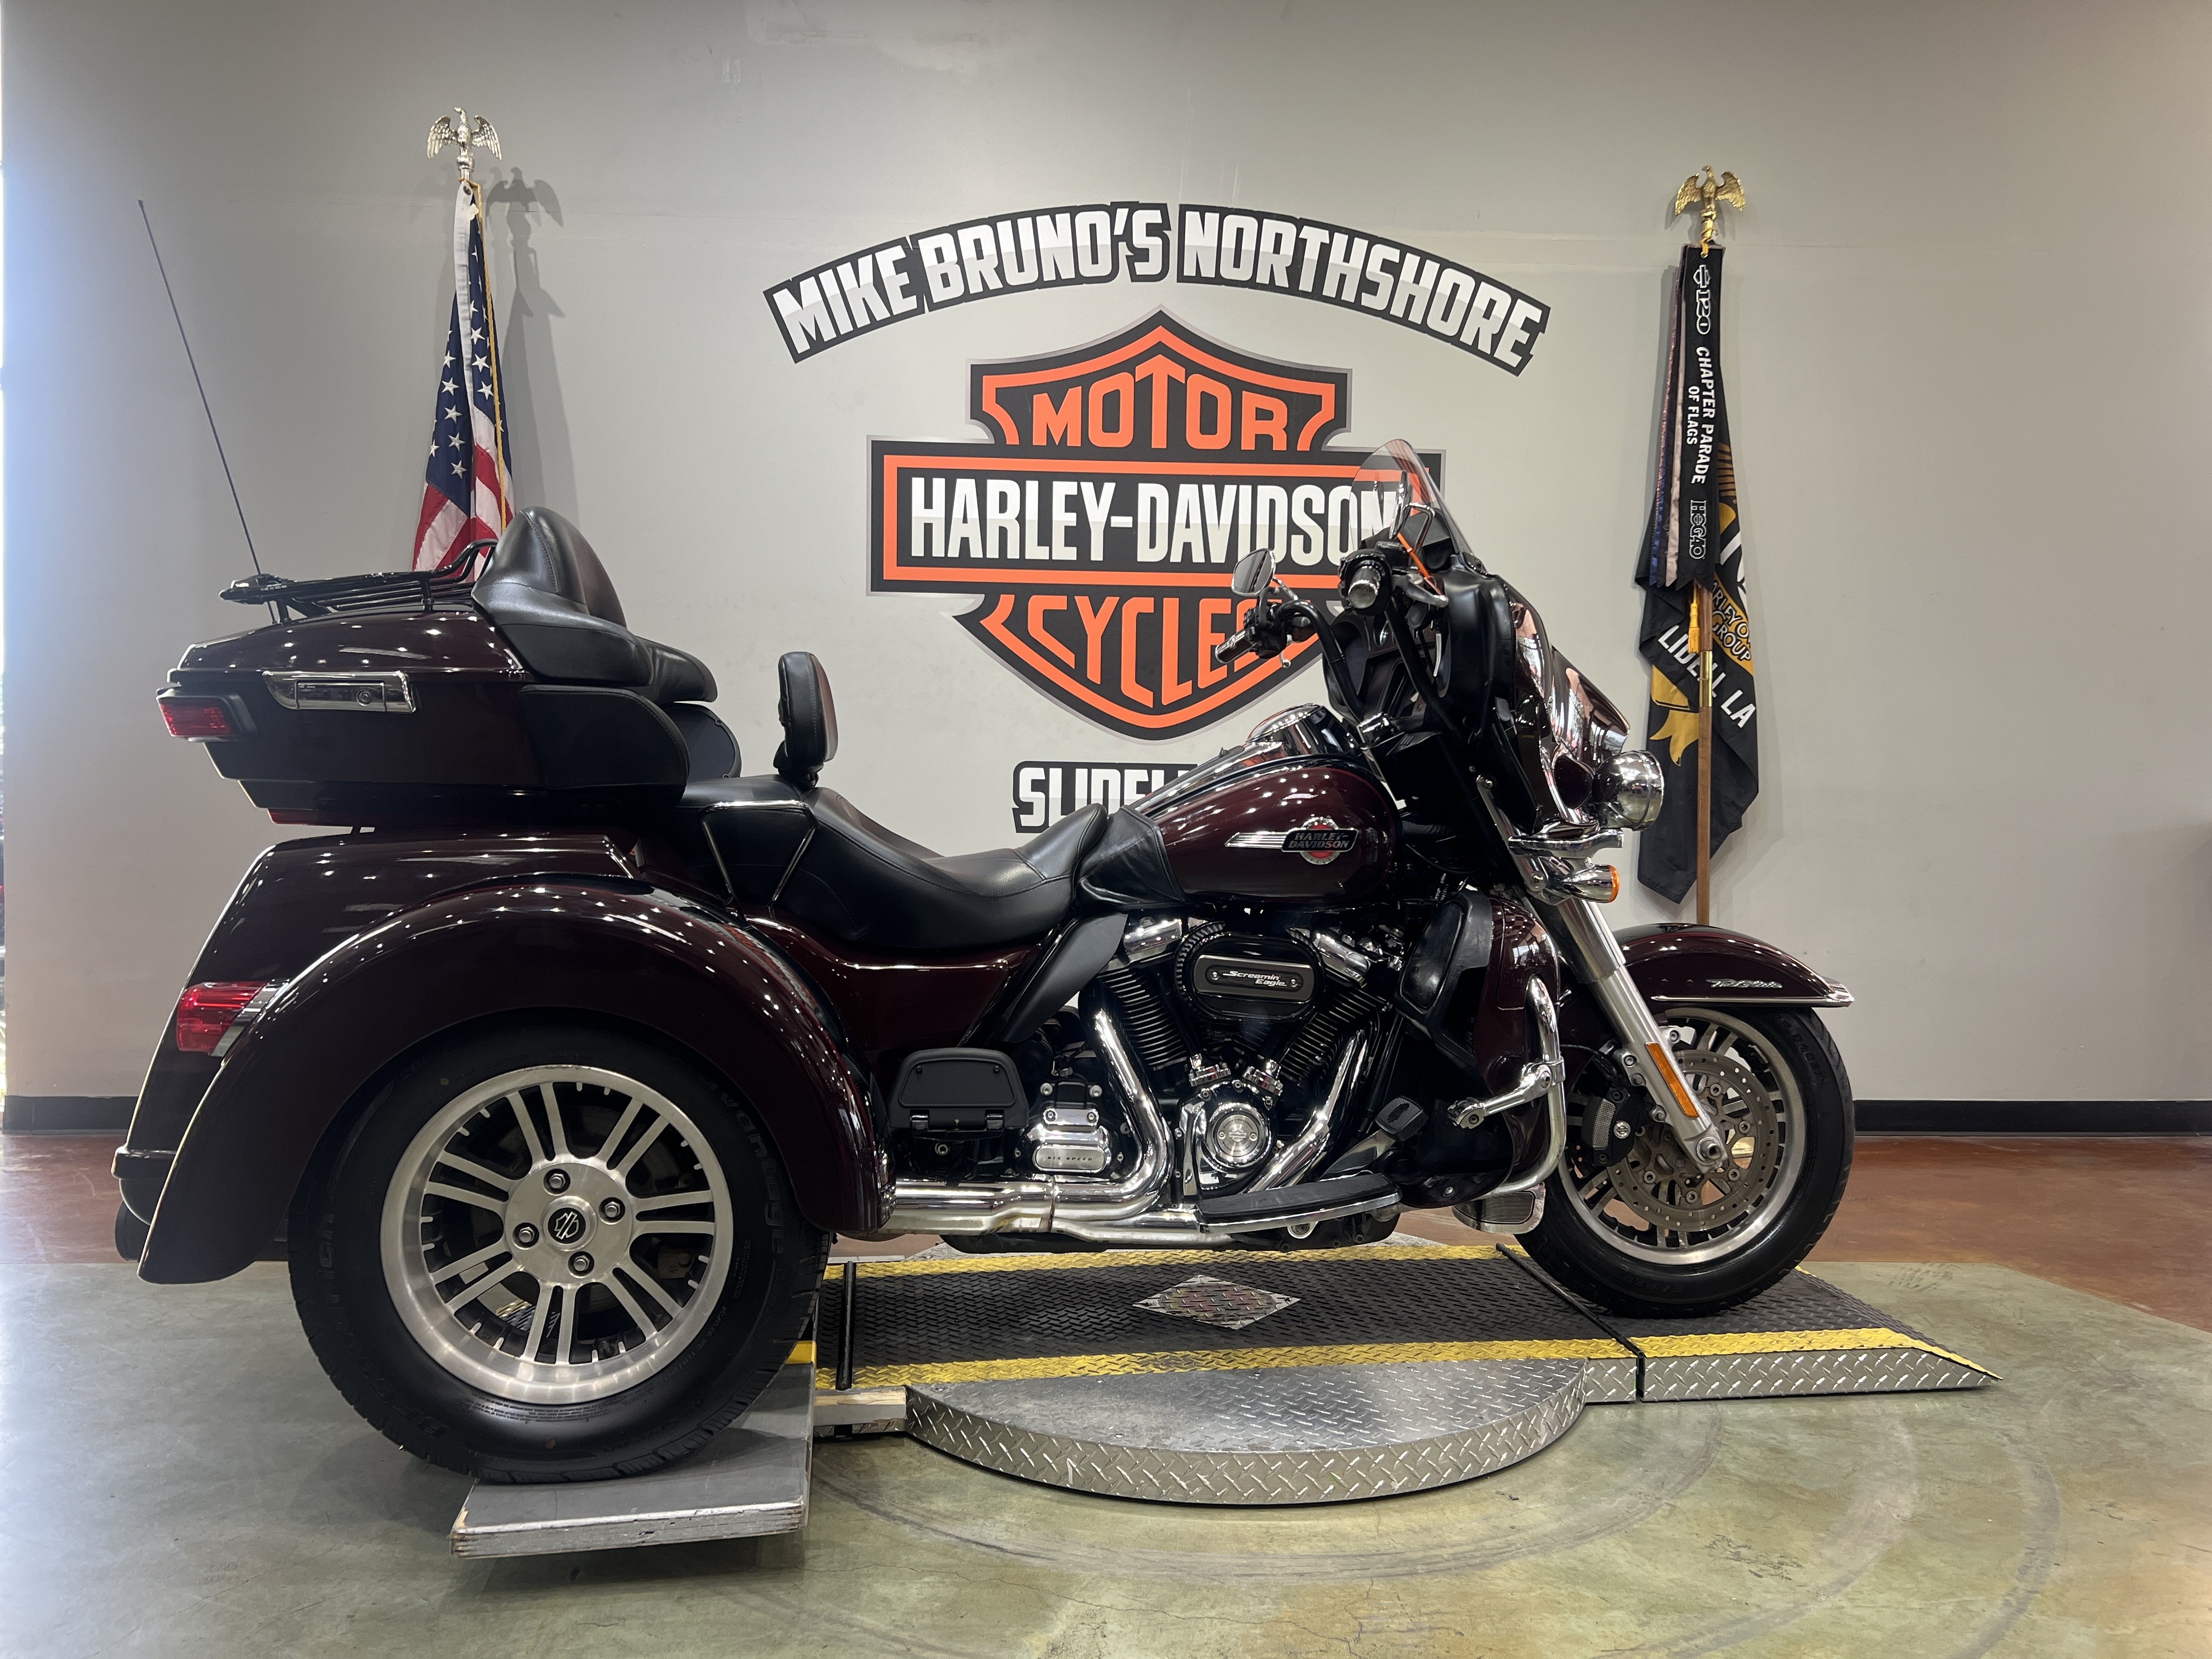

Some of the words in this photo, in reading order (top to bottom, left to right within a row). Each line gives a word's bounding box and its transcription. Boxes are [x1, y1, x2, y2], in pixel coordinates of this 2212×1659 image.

[771, 244, 918, 354] MIKE
[917, 208, 1163, 303] BRUNO'S
[1182, 210, 1543, 368] NORTHSHORE
[1032, 354, 1288, 451] MOTOR
[1688, 385, 1700, 402] OF
[1696, 346, 1716, 419] CHAPTER
[1686, 406, 1700, 445] FLAGS
[1691, 424, 1714, 484] PARADE
[910, 476, 1397, 567] HARLEY-DAVIDSON
[1720, 690, 1756, 729] LA
[1018, 767, 1189, 827] SLIDE
[1294, 832, 1349, 840] HARLEY-
[1222, 970, 1280, 980] Screamin
[1255, 979, 1288, 987] Eagle
